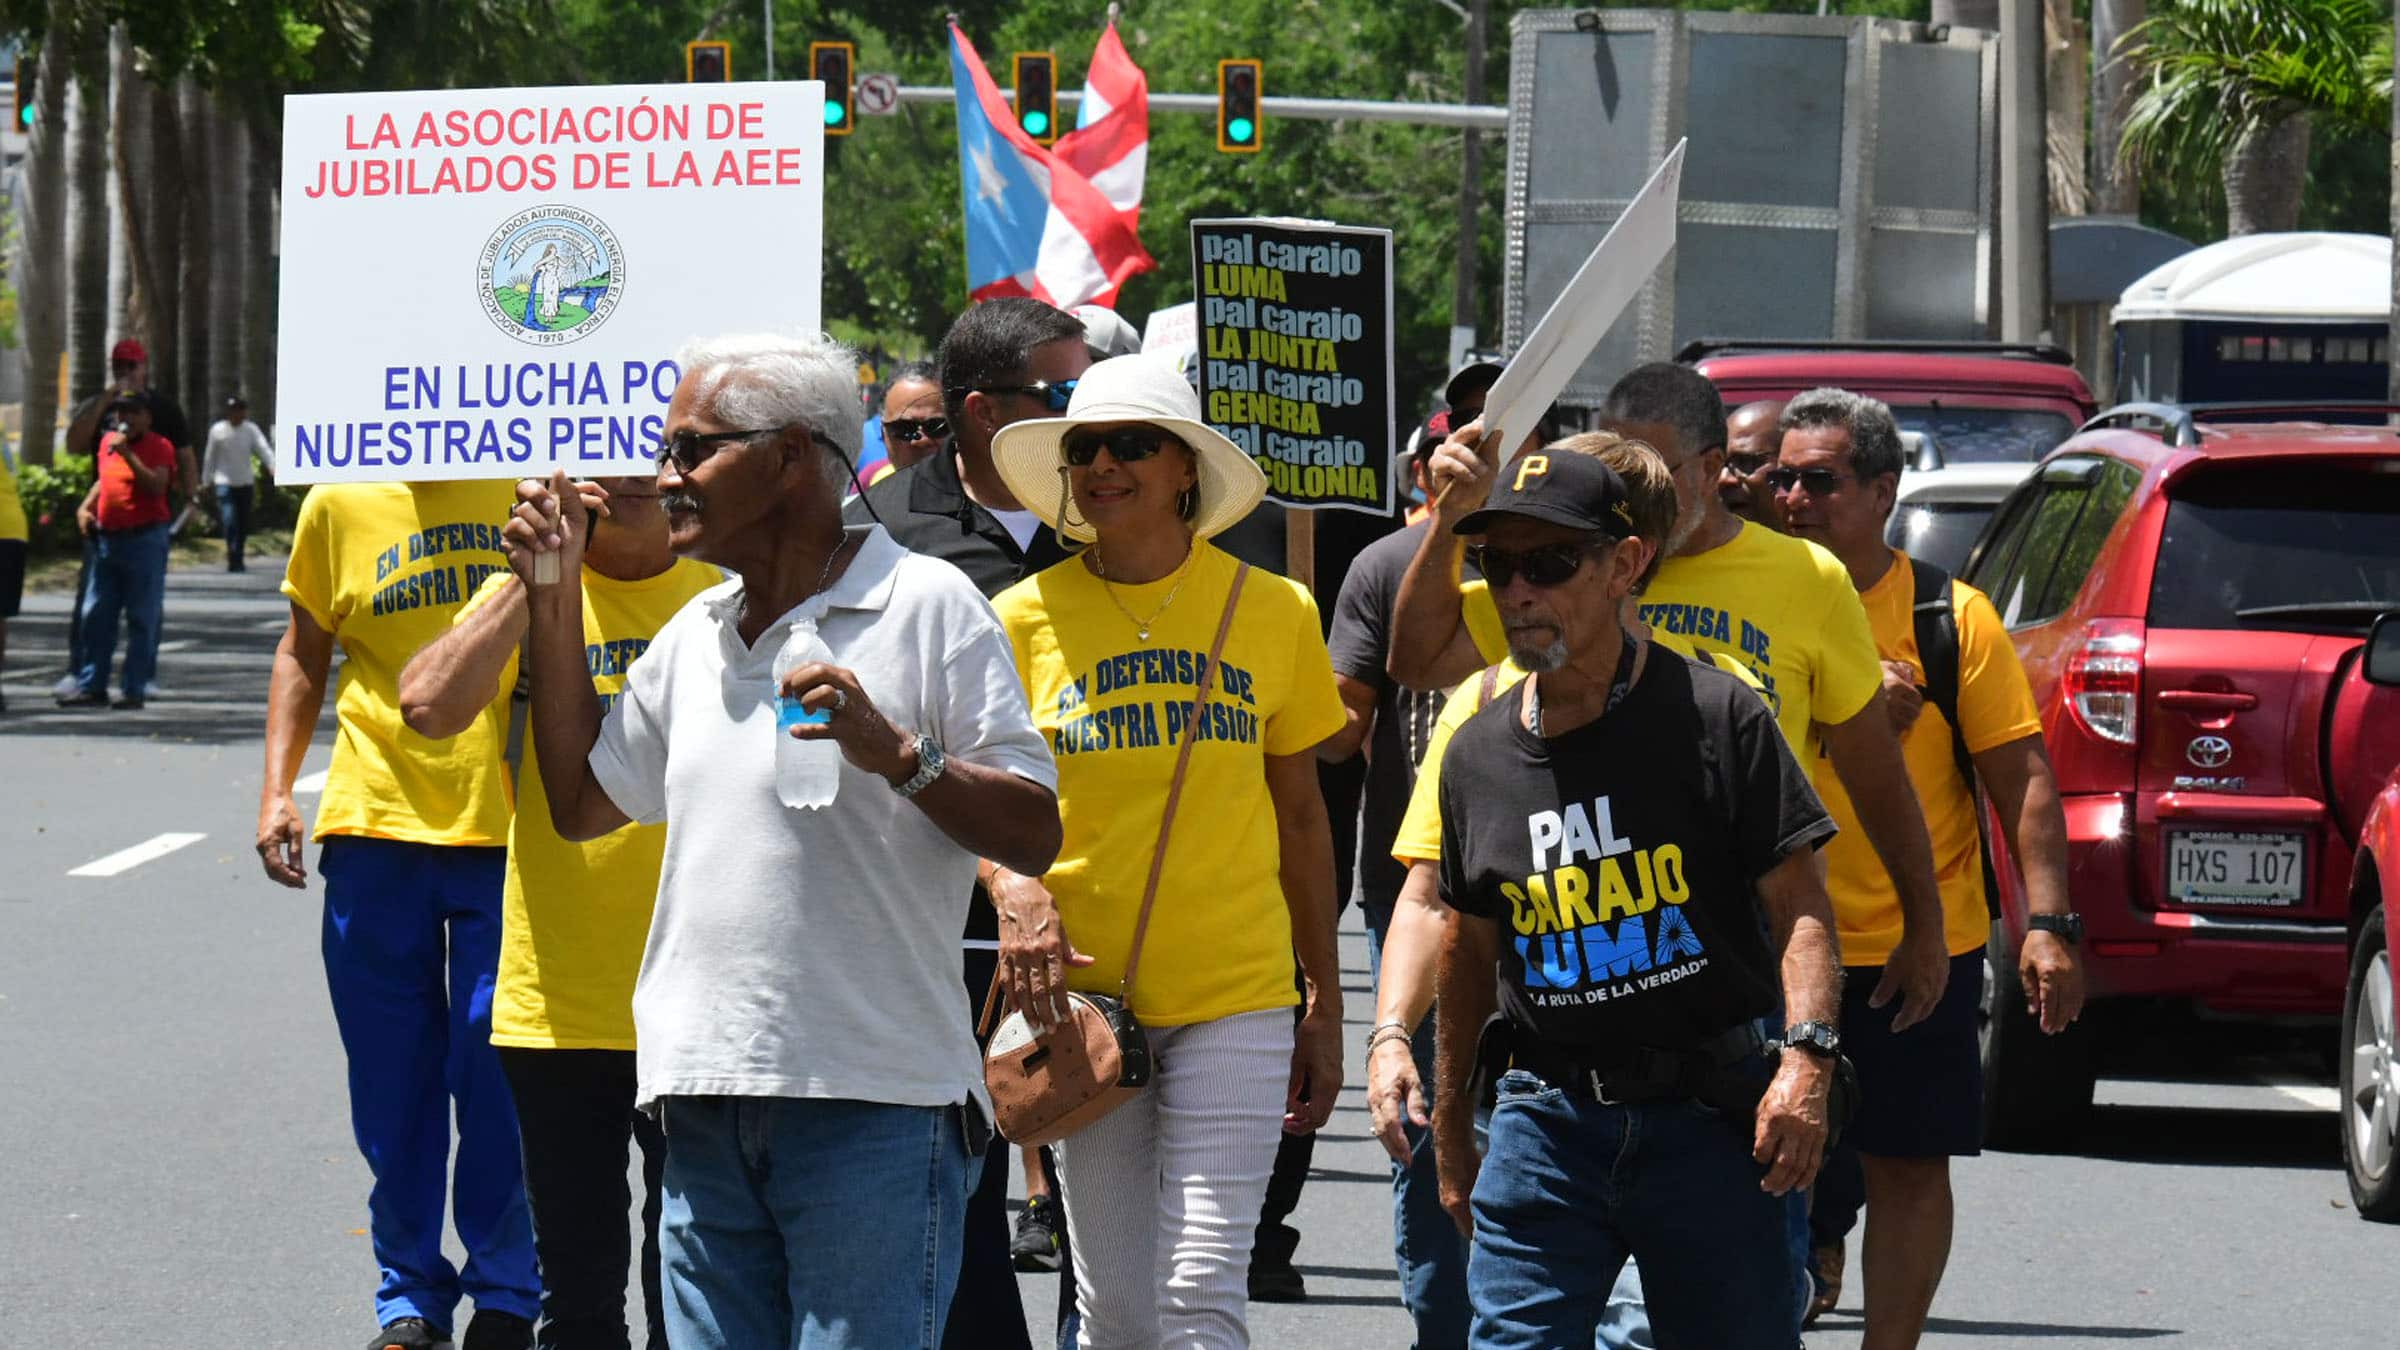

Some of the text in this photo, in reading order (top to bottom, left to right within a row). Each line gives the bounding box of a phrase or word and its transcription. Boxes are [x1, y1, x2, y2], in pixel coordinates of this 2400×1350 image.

[346, 96, 764, 150] LA ASOCIACIÓN DE
[304, 148, 800, 199] JUBILADOS DE LA AEE
[484, 213, 529, 261] JUBILADOS
[530, 207, 594, 228] AUTORIDAD
[592, 223, 608, 238] DE
[480, 265, 491, 280] DE
[1201, 233, 1362, 277] pal carajo
[1203, 264, 1288, 303] LUMA
[1204, 297, 1256, 329] pal
[1261, 303, 1363, 343] carajo
[1206, 327, 1243, 361] LA
[1248, 330, 1339, 372] JUNTA
[385, 365, 441, 411] EN
[458, 361, 608, 409] LUCHA
[1207, 360, 1364, 408] pal carajo
[1208, 390, 1321, 436] GENERA
[295, 418, 533, 468] NUESTRAS
[1266, 431, 1366, 468] carajo
[1512, 455, 1549, 492] P
[376, 542, 401, 584] EN
[372, 566, 460, 617] NUESTRA
[1740, 617, 1771, 667] DE
[1096, 648, 1213, 696] DEFENSA
[1218, 659, 1256, 706] DE
[1528, 795, 1633, 874] PAL
[2176, 847, 2297, 885] HXS 107
[1500, 843, 1691, 936] CARAJO
[1514, 904, 1705, 990] LUMA
[1584, 988, 1608, 1005] DE
[1610, 983, 1636, 999] LA
